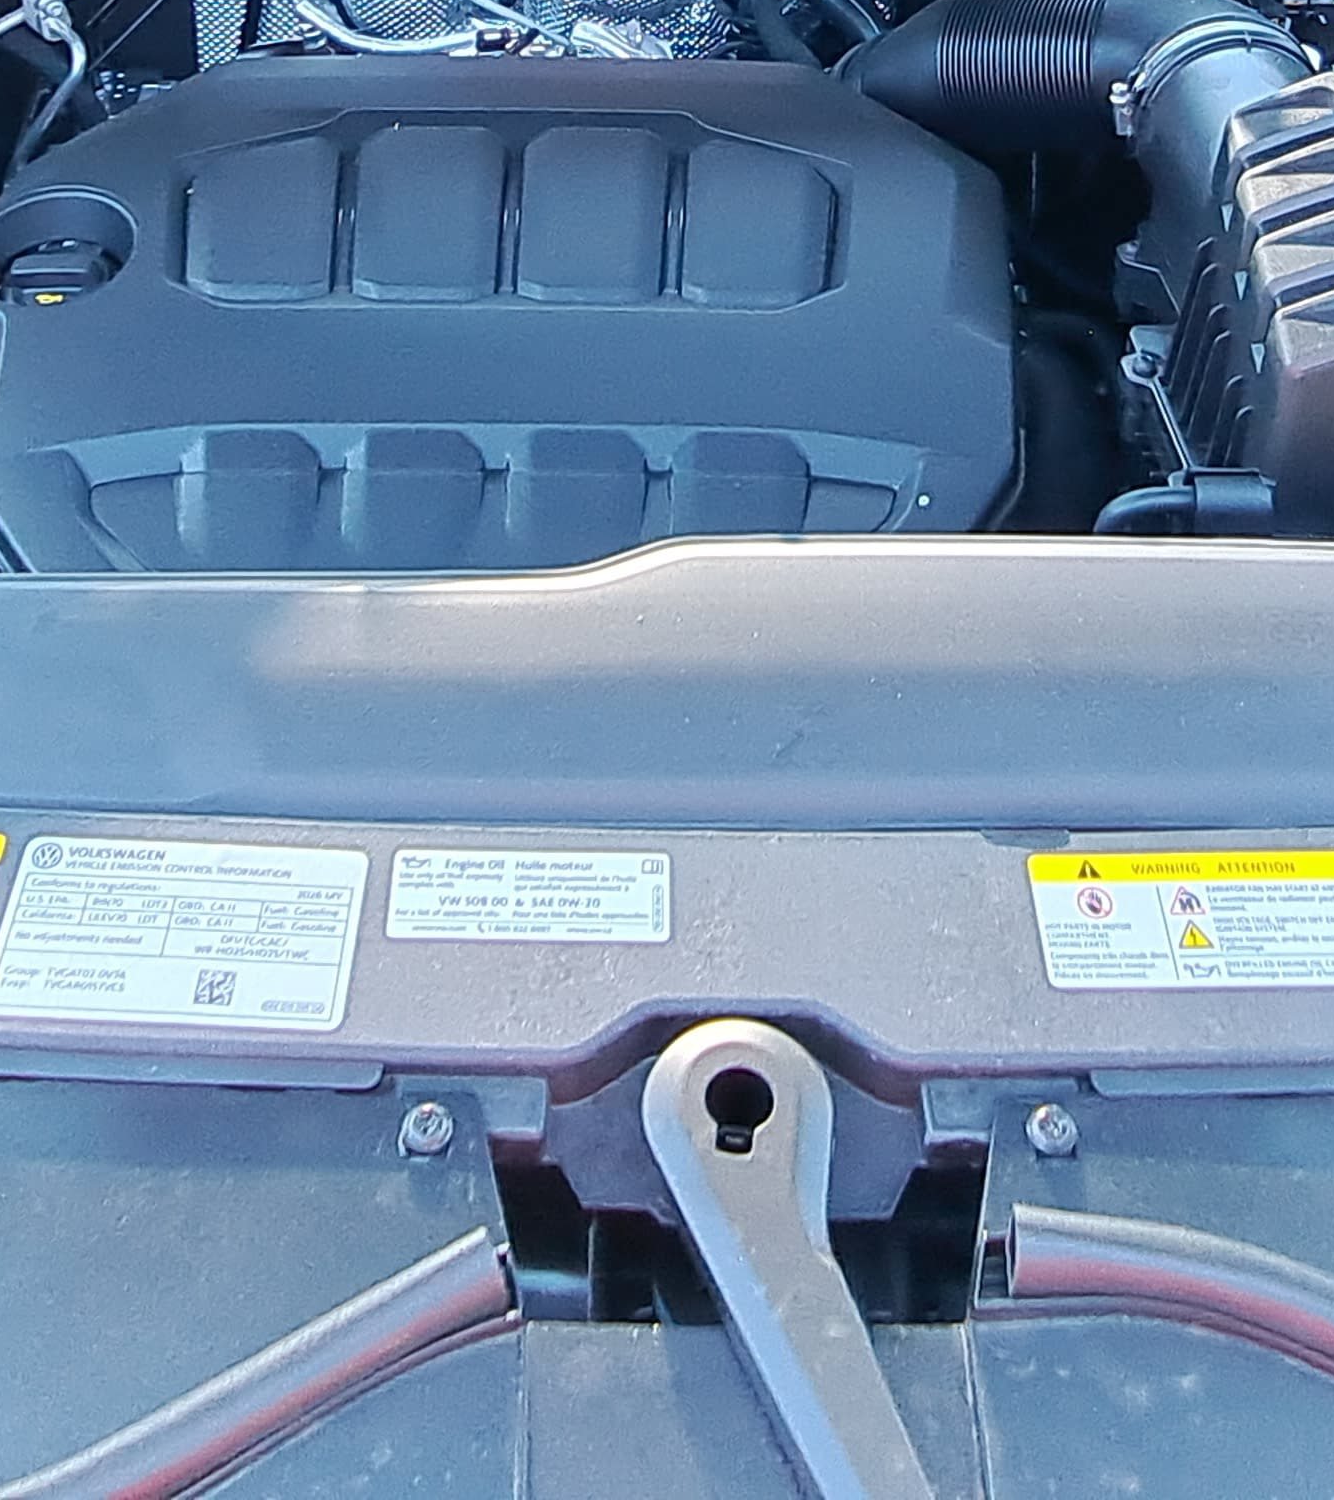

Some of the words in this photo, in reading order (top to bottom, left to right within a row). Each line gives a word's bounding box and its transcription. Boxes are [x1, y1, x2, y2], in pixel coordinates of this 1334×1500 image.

[68, 846, 166, 860] VOLKSWAGEN
[65, 859, 107, 869] VEHICLE
[111, 861, 161, 871] EMISSION
[165, 864, 212, 874] CONTROL
[217, 866, 292, 878] INFORMATION
[443, 858, 485, 871] Engine
[487, 859, 506, 869] Oil
[514, 859, 547, 870] Huile
[548, 861, 594, 870] moteur
[1131, 861, 1201, 875] WARNING
[1218, 860, 1296, 874] ATTENTION
[437, 895, 462, 906] VW
[464, 895, 488, 906] 508
[490, 896, 508, 907] 00
[530, 896, 554, 908] SAE
